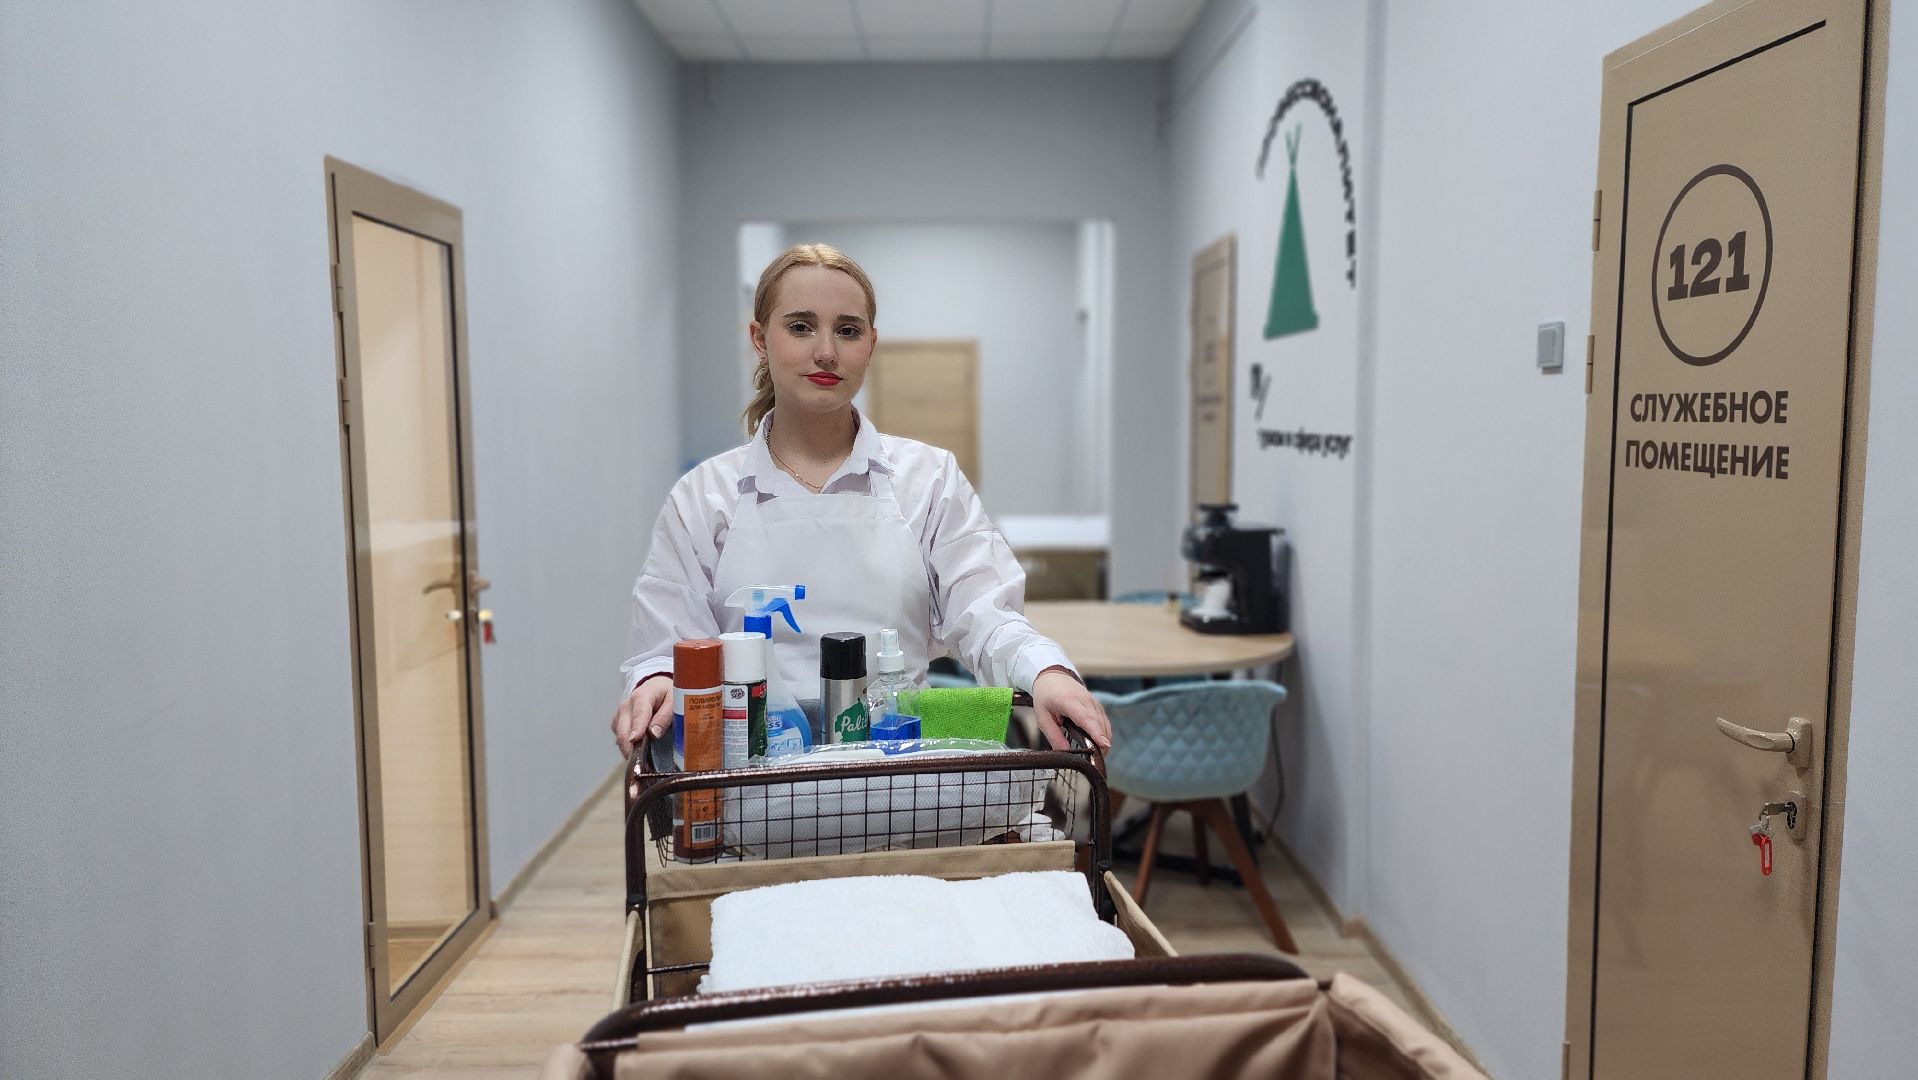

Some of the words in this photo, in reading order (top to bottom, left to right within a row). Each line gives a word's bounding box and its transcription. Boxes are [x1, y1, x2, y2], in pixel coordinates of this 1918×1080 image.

[1667, 230, 1750, 301] 121
[1630, 390, 1789, 424] СЛУЖЕБНОЕ
[1625, 440, 1790, 479] ПОМЕЩЕНИЕ
